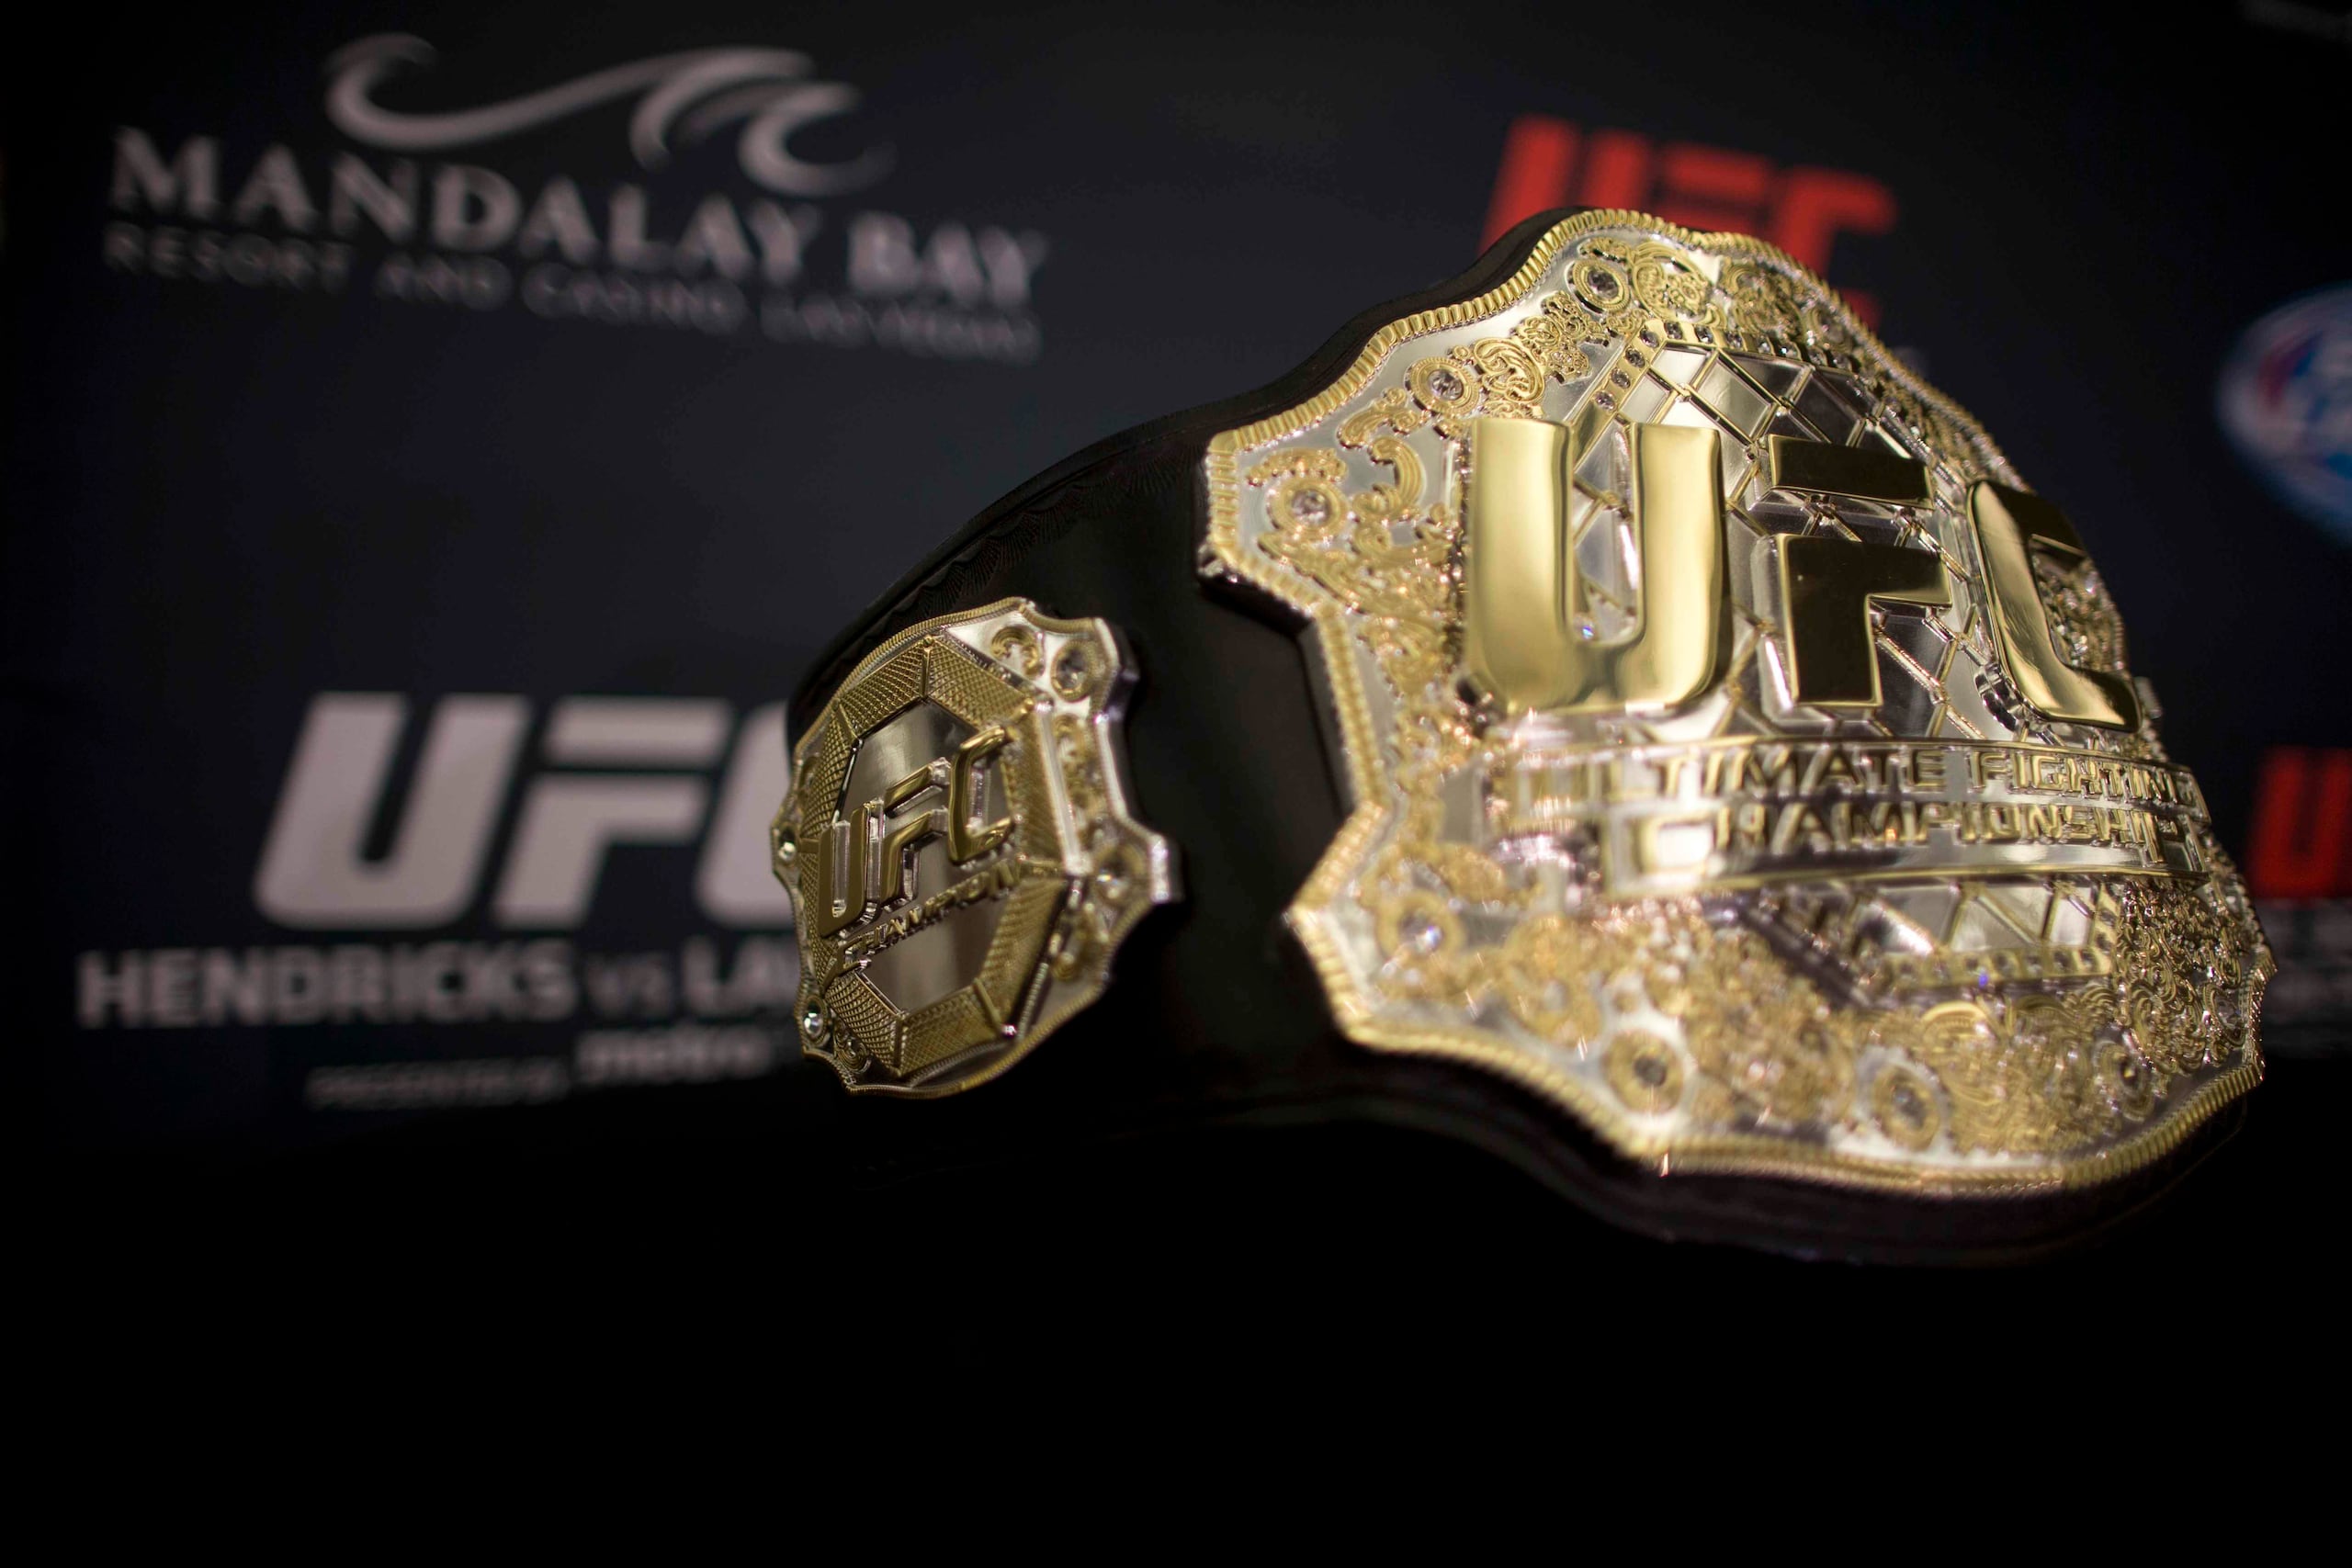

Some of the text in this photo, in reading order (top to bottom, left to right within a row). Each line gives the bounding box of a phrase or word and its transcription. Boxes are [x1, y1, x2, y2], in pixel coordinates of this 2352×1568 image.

[103, 220, 351, 292] RESORT
[376, 252, 514, 312] AND
[520, 263, 748, 334] CASINO
[108, 125, 1049, 307] MANDALAY BAY
[1468, 415, 2141, 733] UFC
[818, 726, 1016, 939] UFC
[1604, 797, 2181, 889] CHAMPIONSHIP
[75, 939, 577, 1029] HENDRICKS
